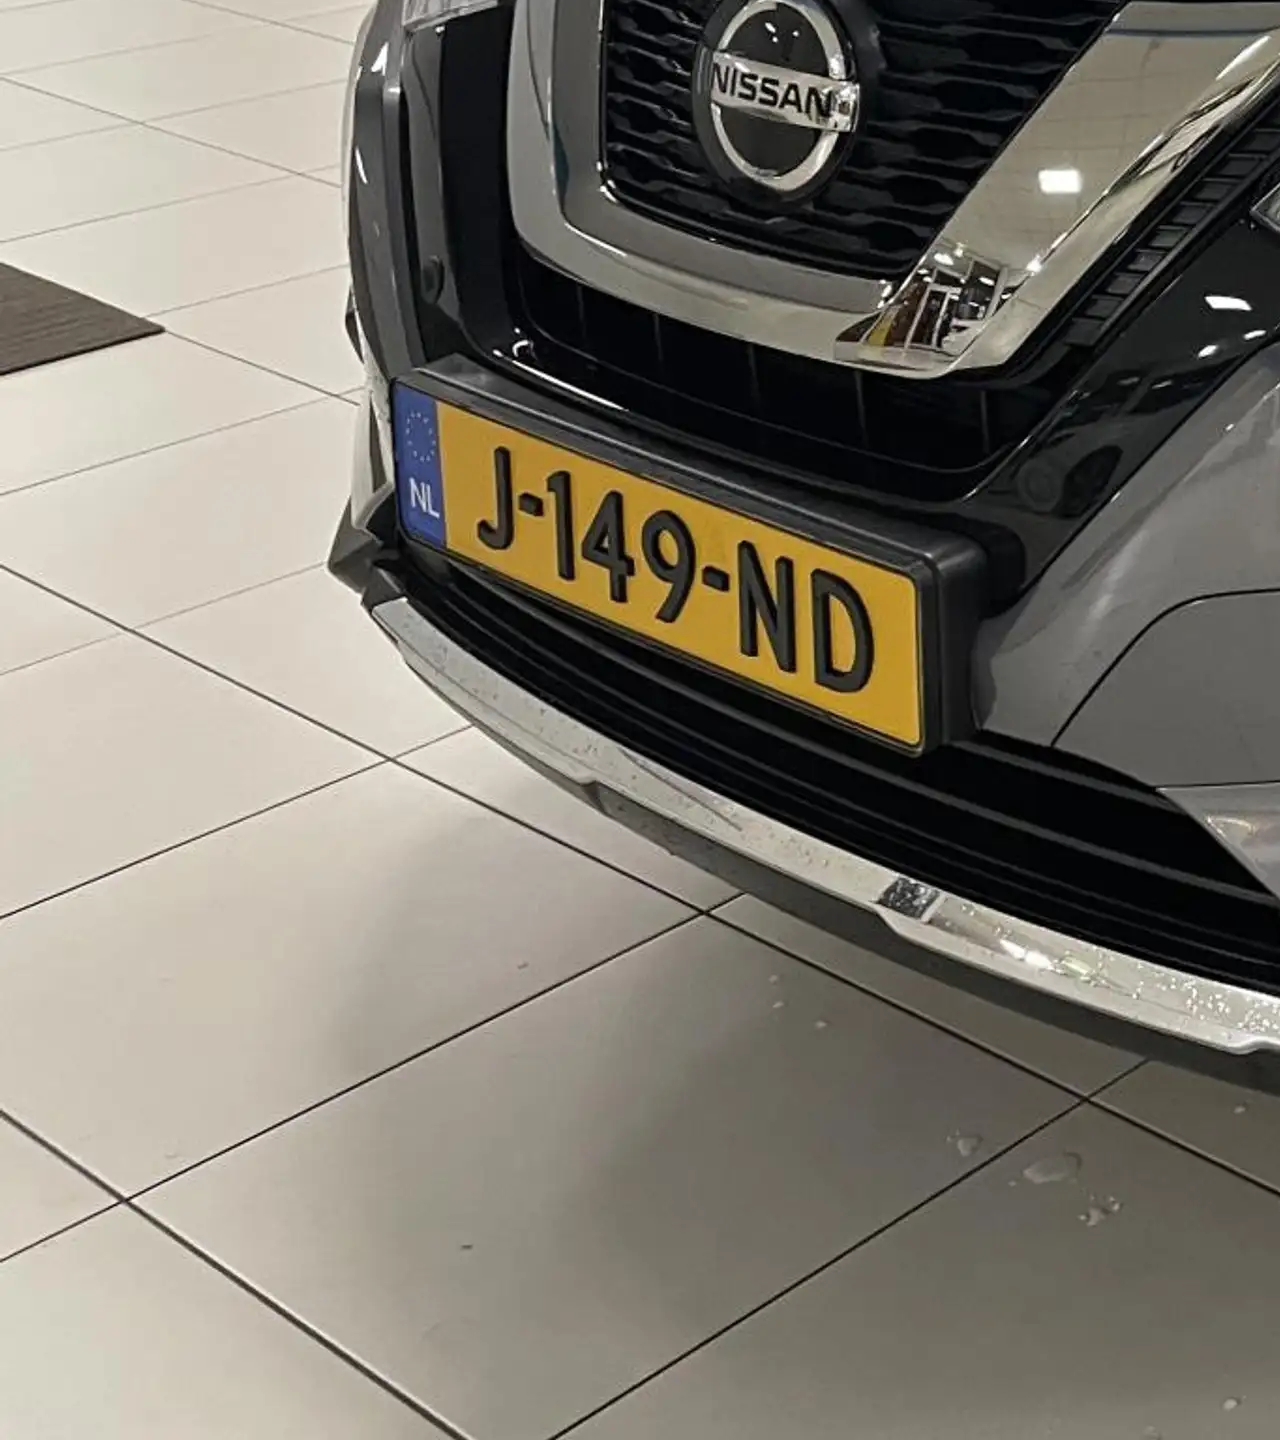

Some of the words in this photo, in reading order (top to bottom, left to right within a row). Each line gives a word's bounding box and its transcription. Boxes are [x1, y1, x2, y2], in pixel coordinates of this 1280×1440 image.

[711, 63, 833, 118] NISSAN
[408, 477, 441, 520] NL
[477, 445, 876, 693] J-149-ND
